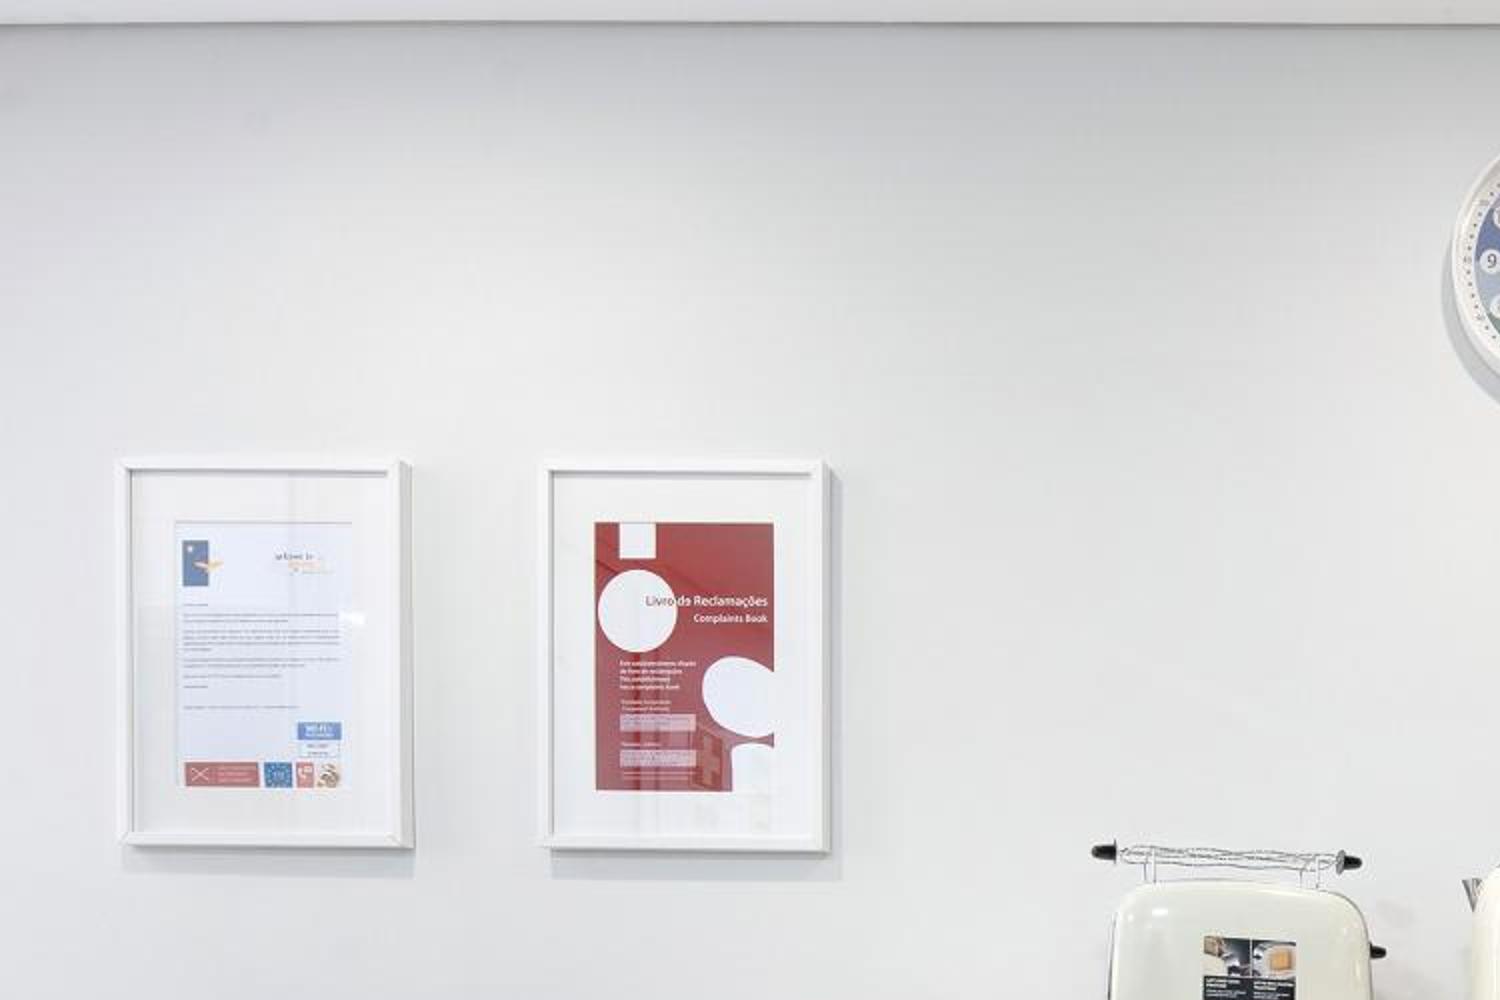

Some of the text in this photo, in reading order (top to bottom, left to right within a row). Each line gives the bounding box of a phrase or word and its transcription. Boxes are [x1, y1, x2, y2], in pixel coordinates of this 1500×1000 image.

[1487, 253, 1498, 269] 9
[646, 595, 769, 609] Livro de Reclamações
[693, 613, 769, 625] Complaints Book
